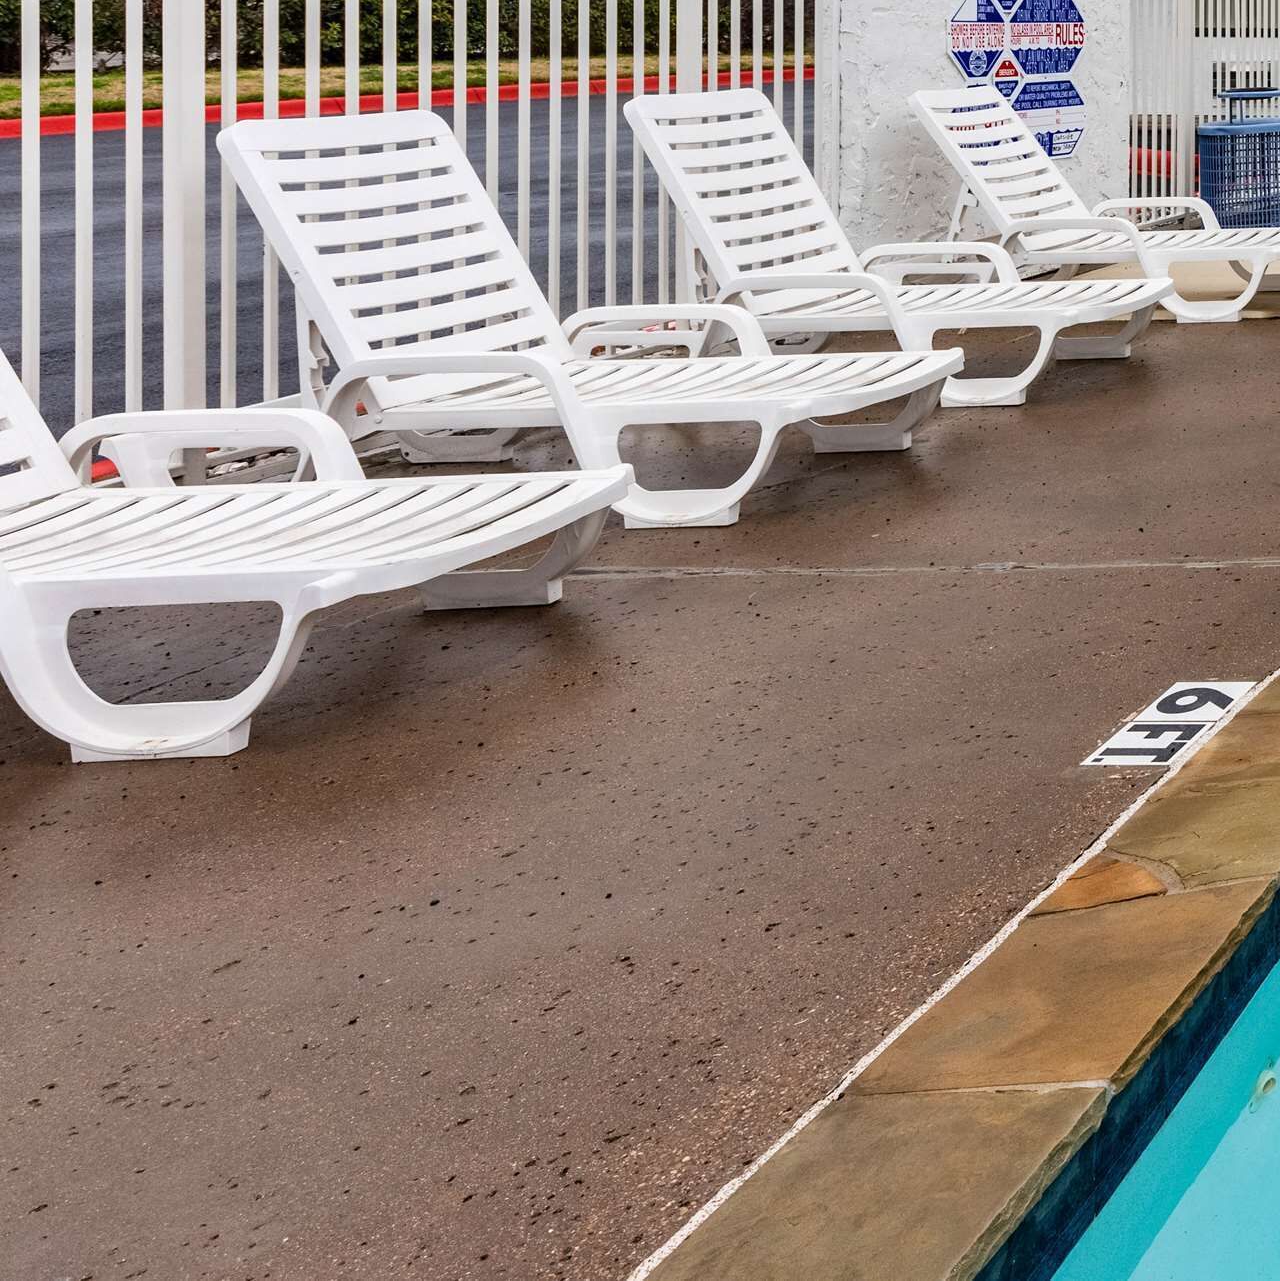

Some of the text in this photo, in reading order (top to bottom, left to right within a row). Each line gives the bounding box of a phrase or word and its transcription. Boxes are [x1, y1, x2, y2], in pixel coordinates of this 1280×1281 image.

[951, 23, 1005, 36] SHOWER BEFORE ENTERING
[1055, 23, 1084, 46] RULES
[951, 35, 1004, 49] DO NOT USE ALONE
[1156, 687, 1234, 714] 6
